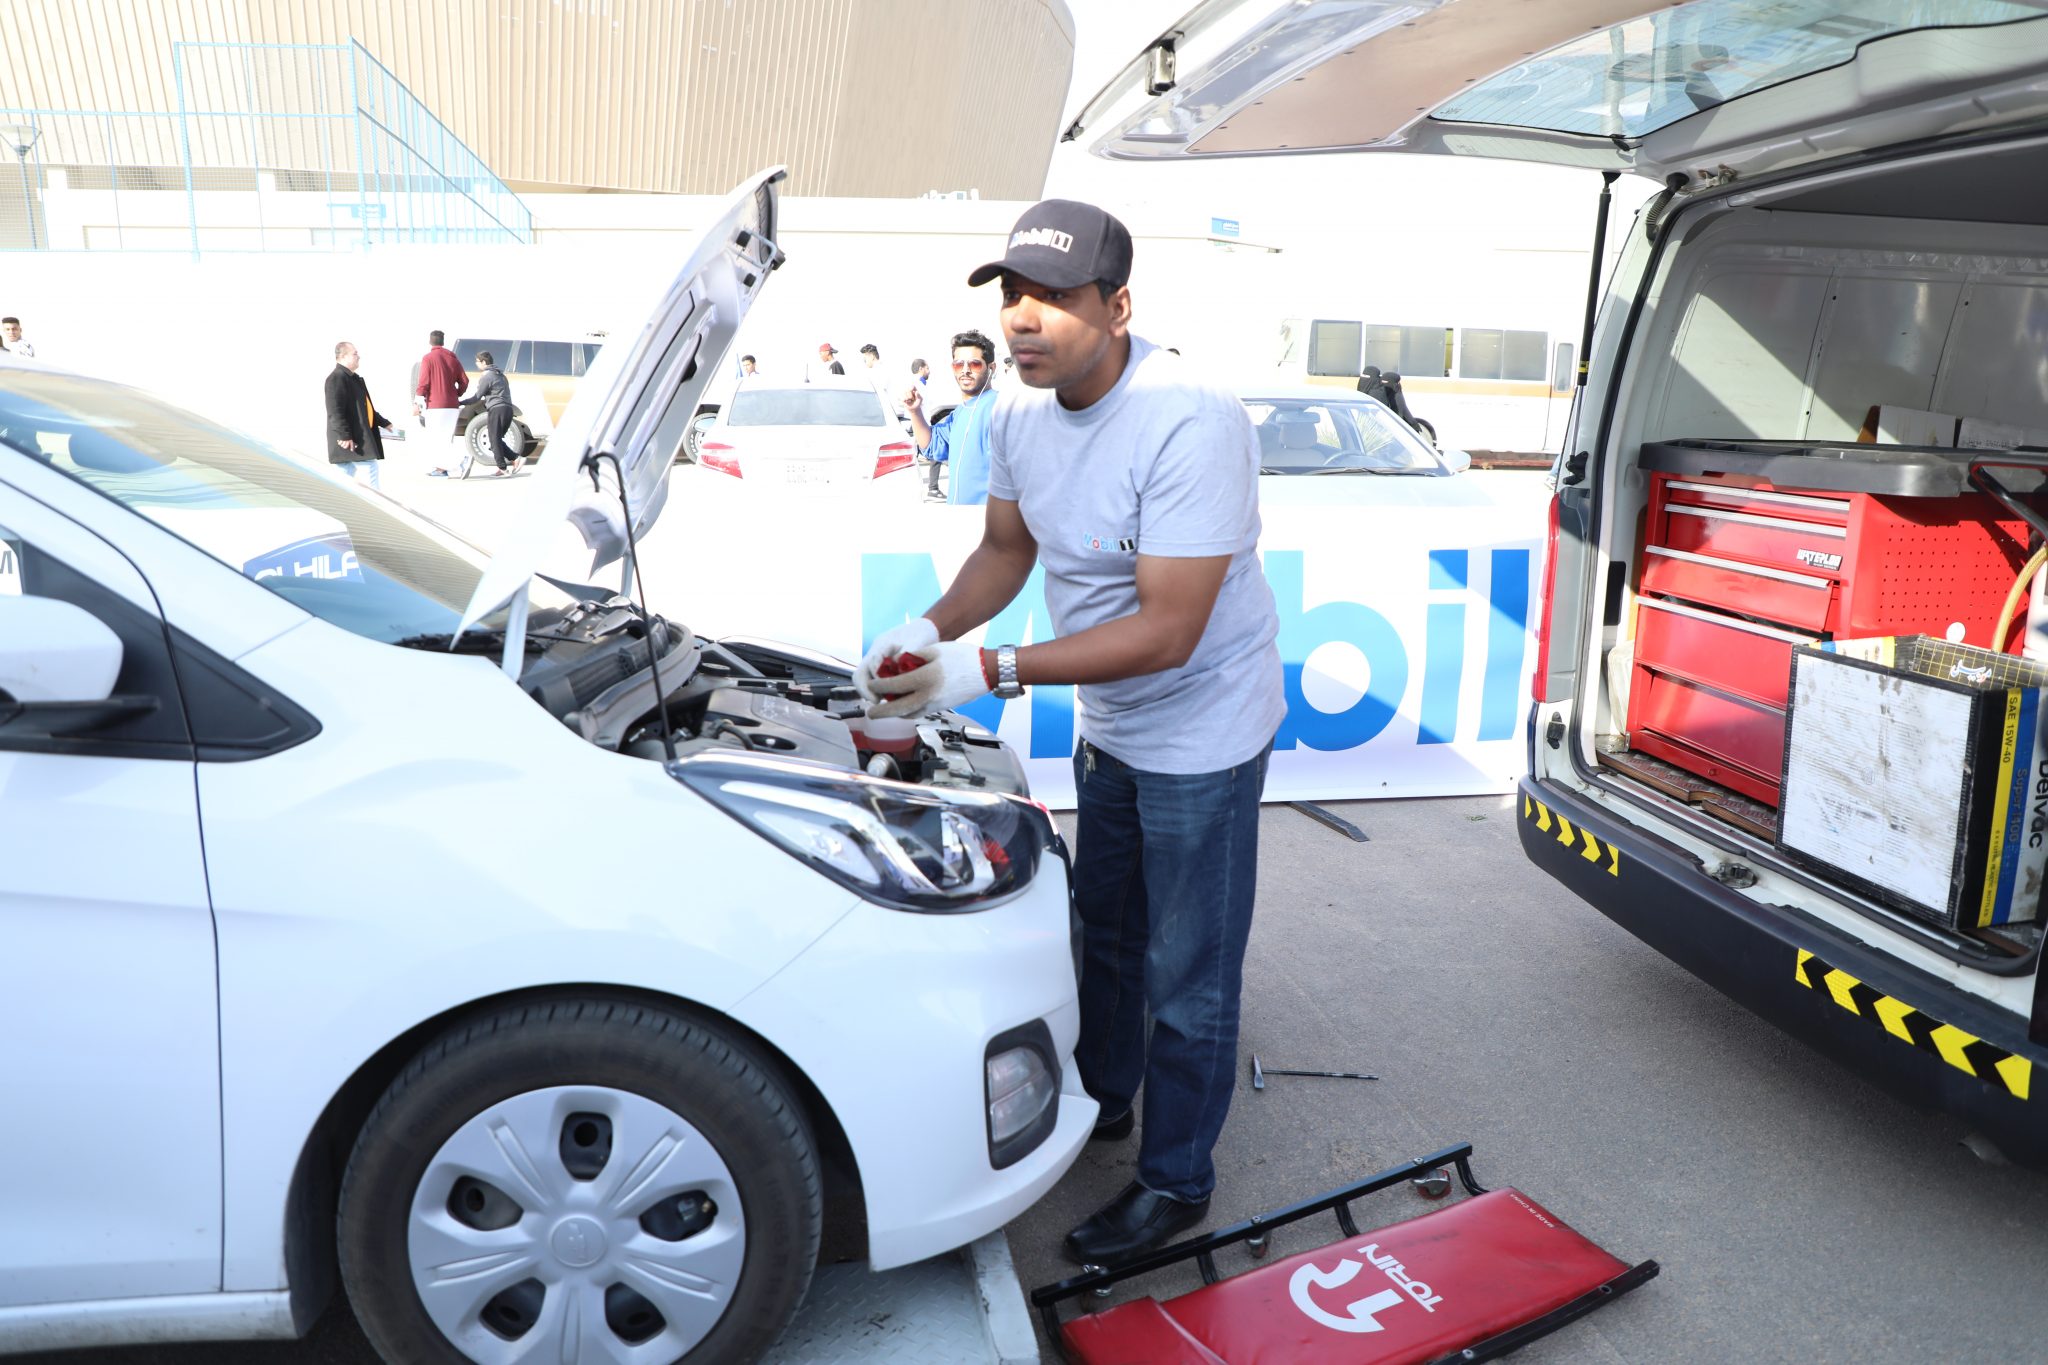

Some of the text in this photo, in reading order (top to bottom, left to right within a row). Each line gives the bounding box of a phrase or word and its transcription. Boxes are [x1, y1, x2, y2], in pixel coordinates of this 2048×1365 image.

[861, 549, 1531, 759] Mbil
[2003, 696, 2018, 763] SAE 15W-40
[1357, 1243, 1444, 1313] TORIN
